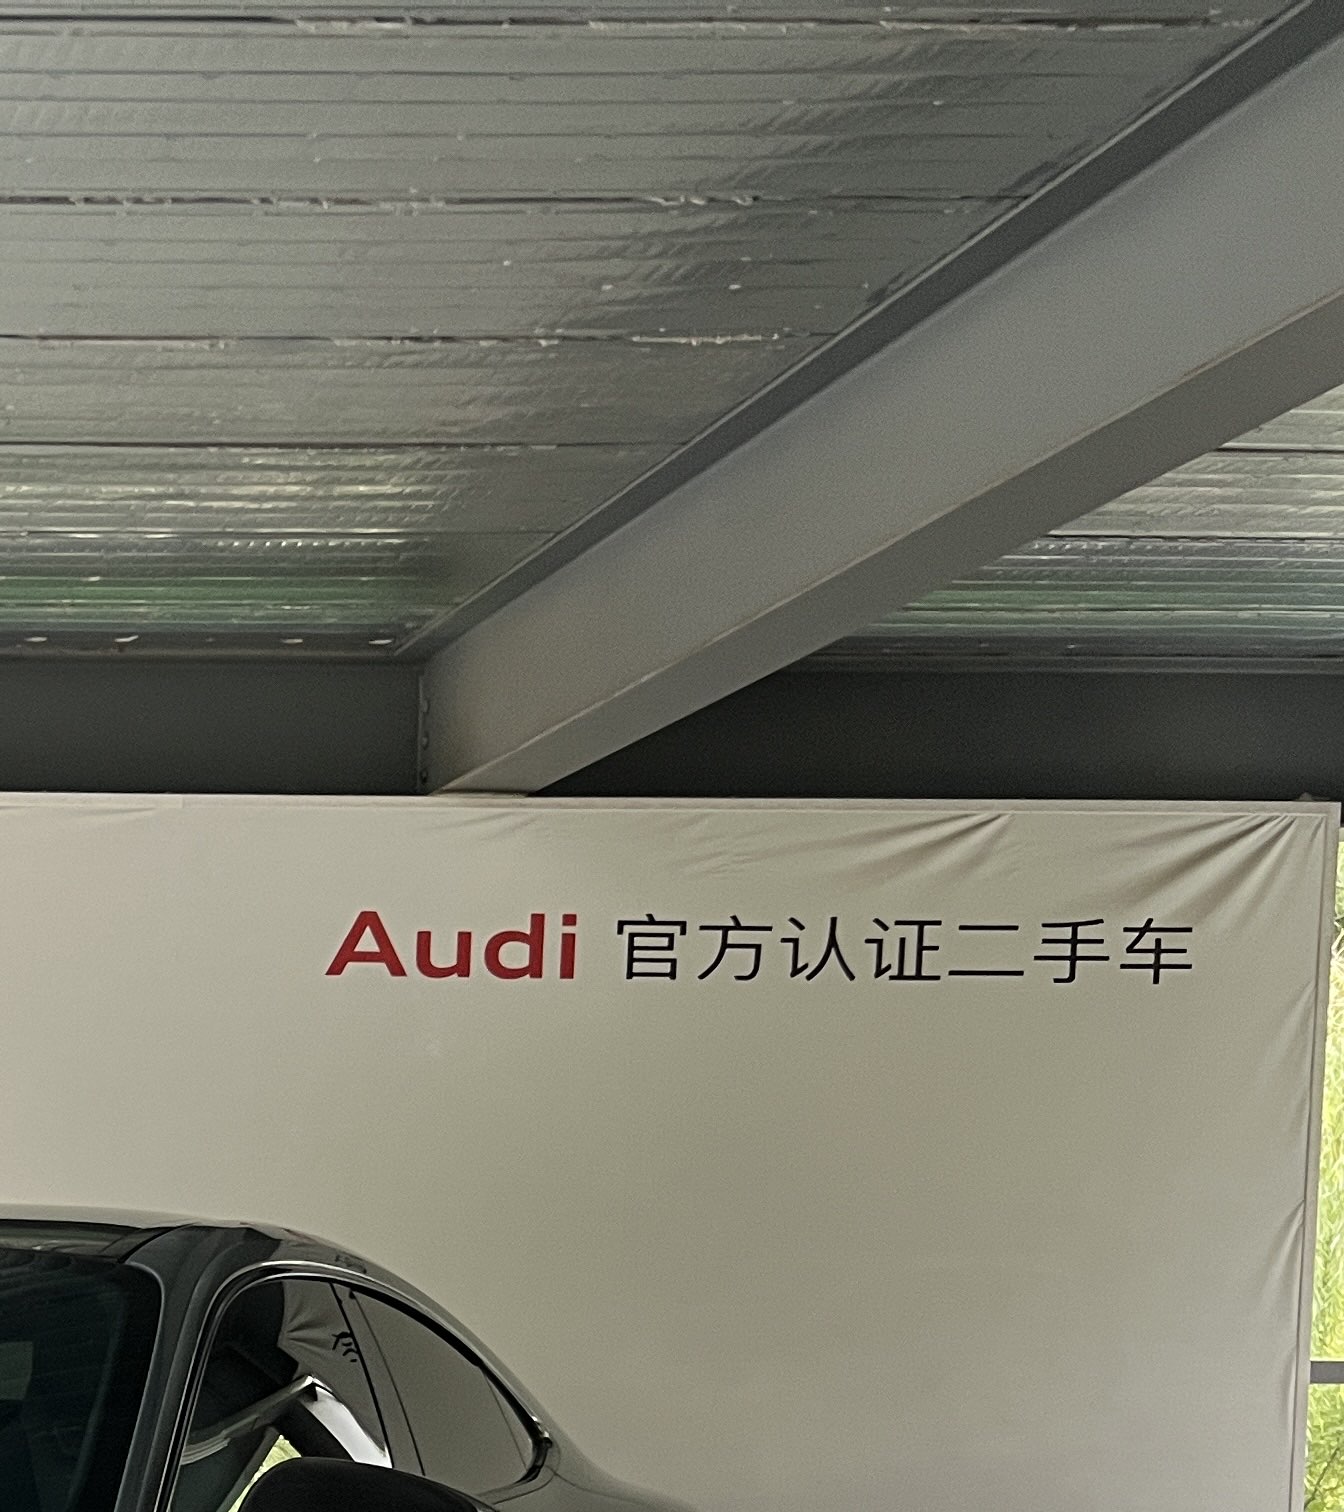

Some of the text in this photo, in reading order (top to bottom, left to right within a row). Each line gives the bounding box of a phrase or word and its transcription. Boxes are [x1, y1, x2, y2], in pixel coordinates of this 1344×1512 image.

[325, 910, 1194, 985] Audi 官方认证二手车
